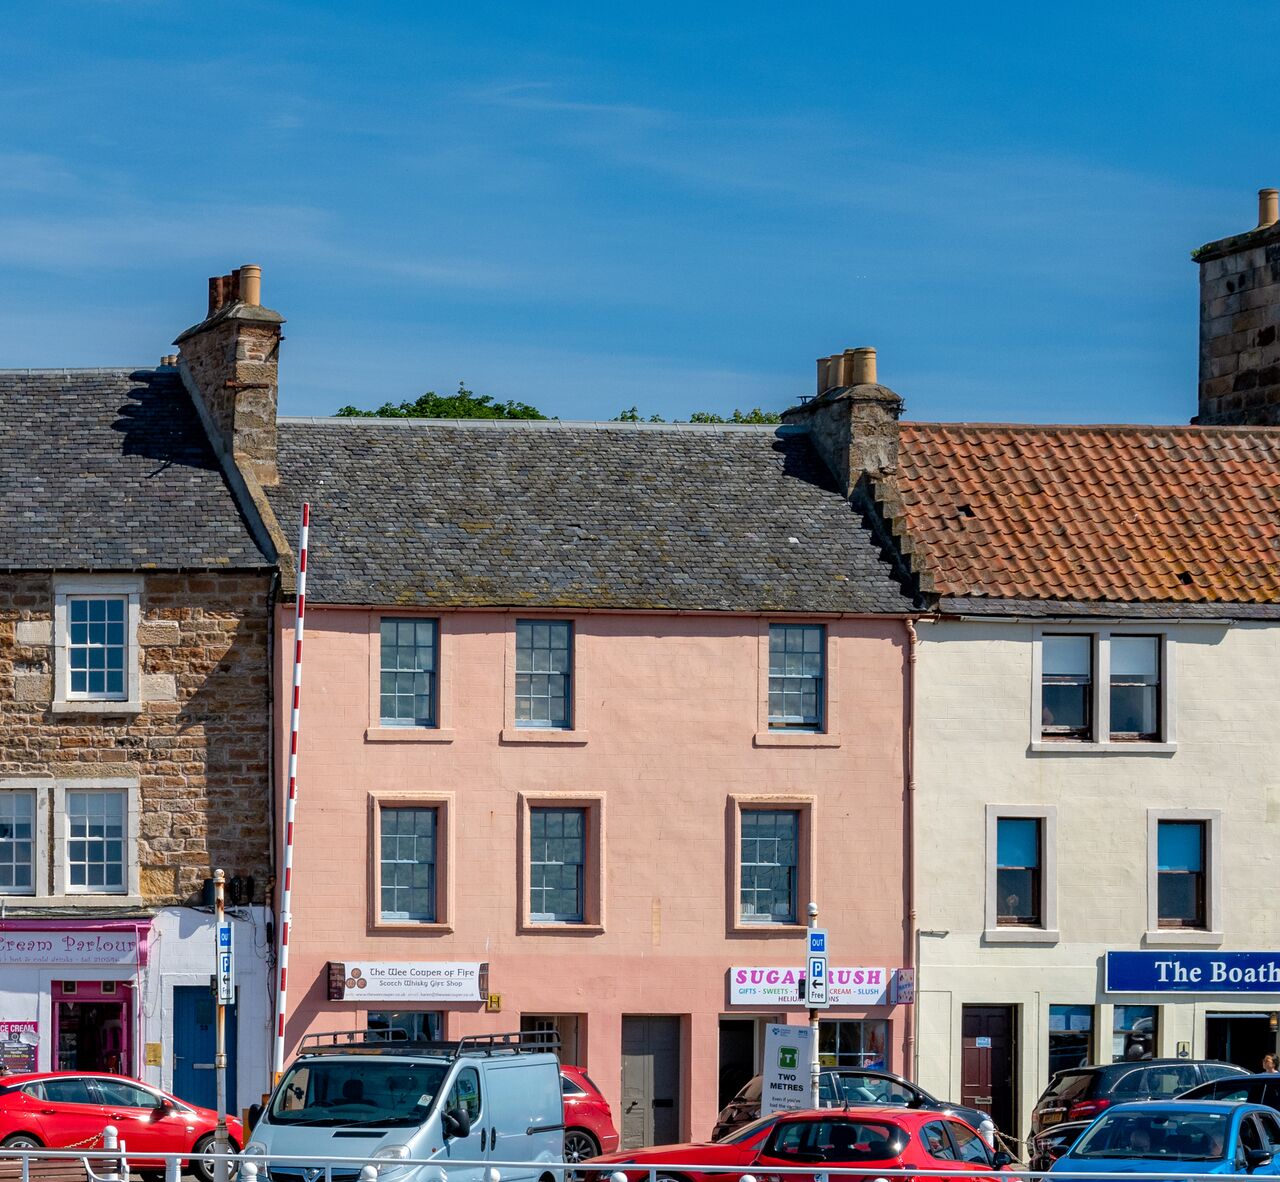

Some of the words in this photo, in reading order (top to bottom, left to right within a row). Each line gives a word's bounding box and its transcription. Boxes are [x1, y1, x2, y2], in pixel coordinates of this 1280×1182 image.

[61, 936, 136, 952] Parlour
[812, 939, 824, 947] OUT
[370, 968, 386, 976] The
[388, 968, 407, 976] Wee
[410, 968, 442, 978] Couper
[457, 968, 475, 977] Fife
[815, 962, 822, 976] P
[1154, 961, 1202, 983] The
[1209, 961, 1280, 983] Boath
[404, 980, 428, 988] Whisky
[430, 980, 444, 988] Gift
[446, 980, 463, 988] Shop
[811, 991, 825, 999] Free
[778, 1073, 797, 1082] TWO
[770, 1082, 804, 1092] METRES
